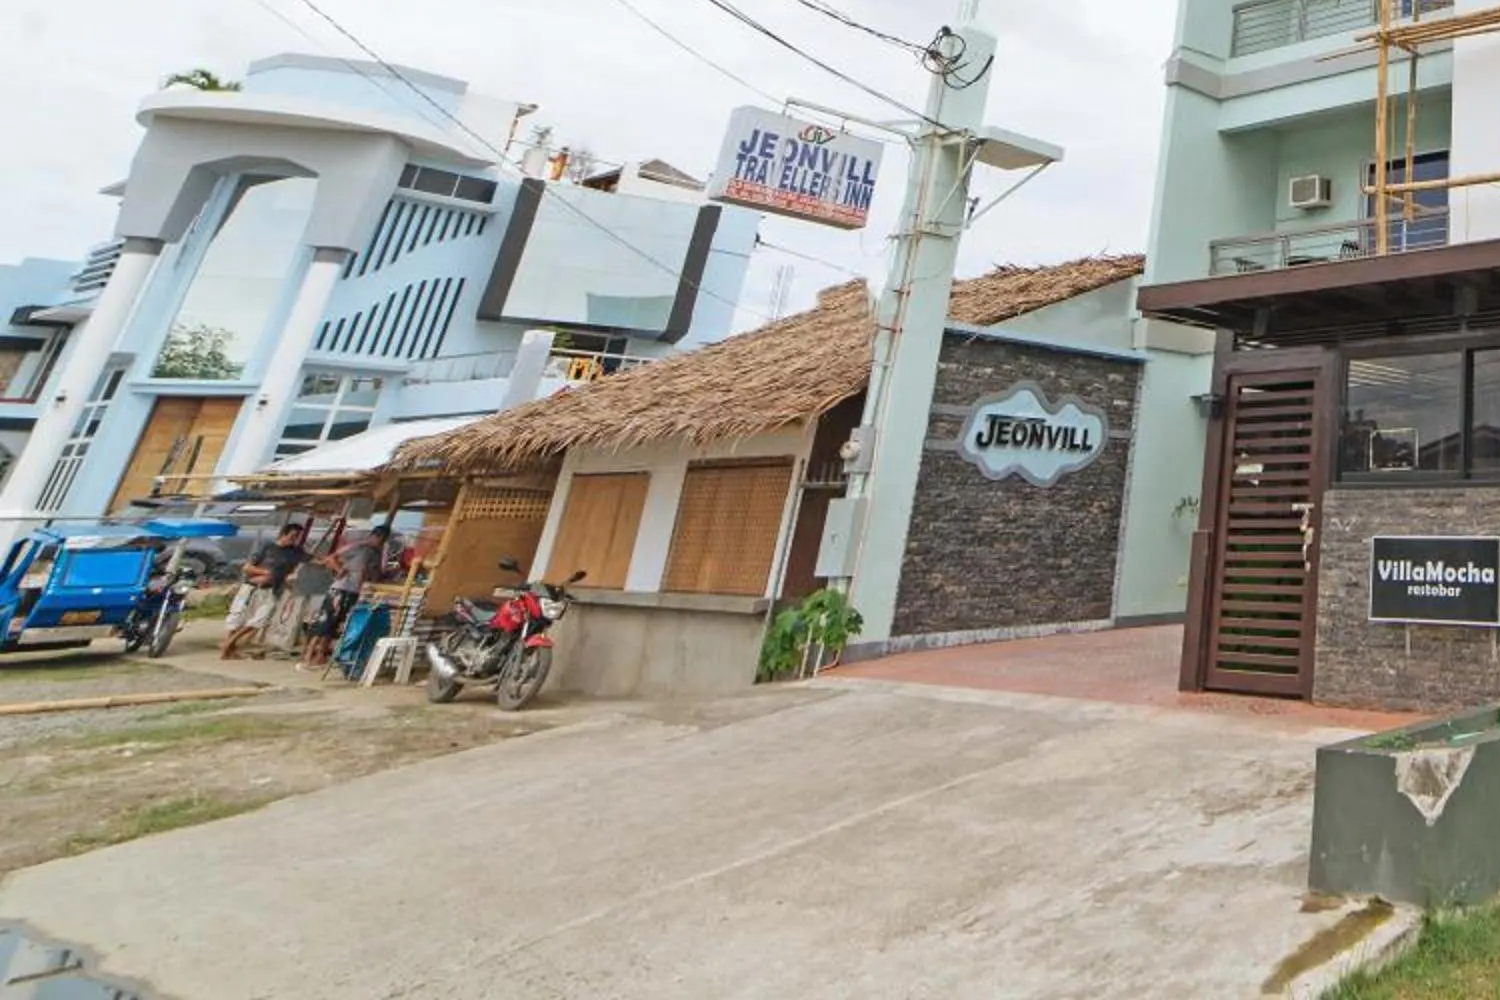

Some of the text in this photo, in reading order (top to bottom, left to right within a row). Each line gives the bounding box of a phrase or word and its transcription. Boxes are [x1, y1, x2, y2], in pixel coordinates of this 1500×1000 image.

[739, 129, 876, 186] JEONVILL
[843, 181, 875, 212] INN
[976, 414, 1093, 451] JEONVILL
[1377, 560, 1495, 584] VillaMocha
[1407, 584, 1462, 597] restobar
